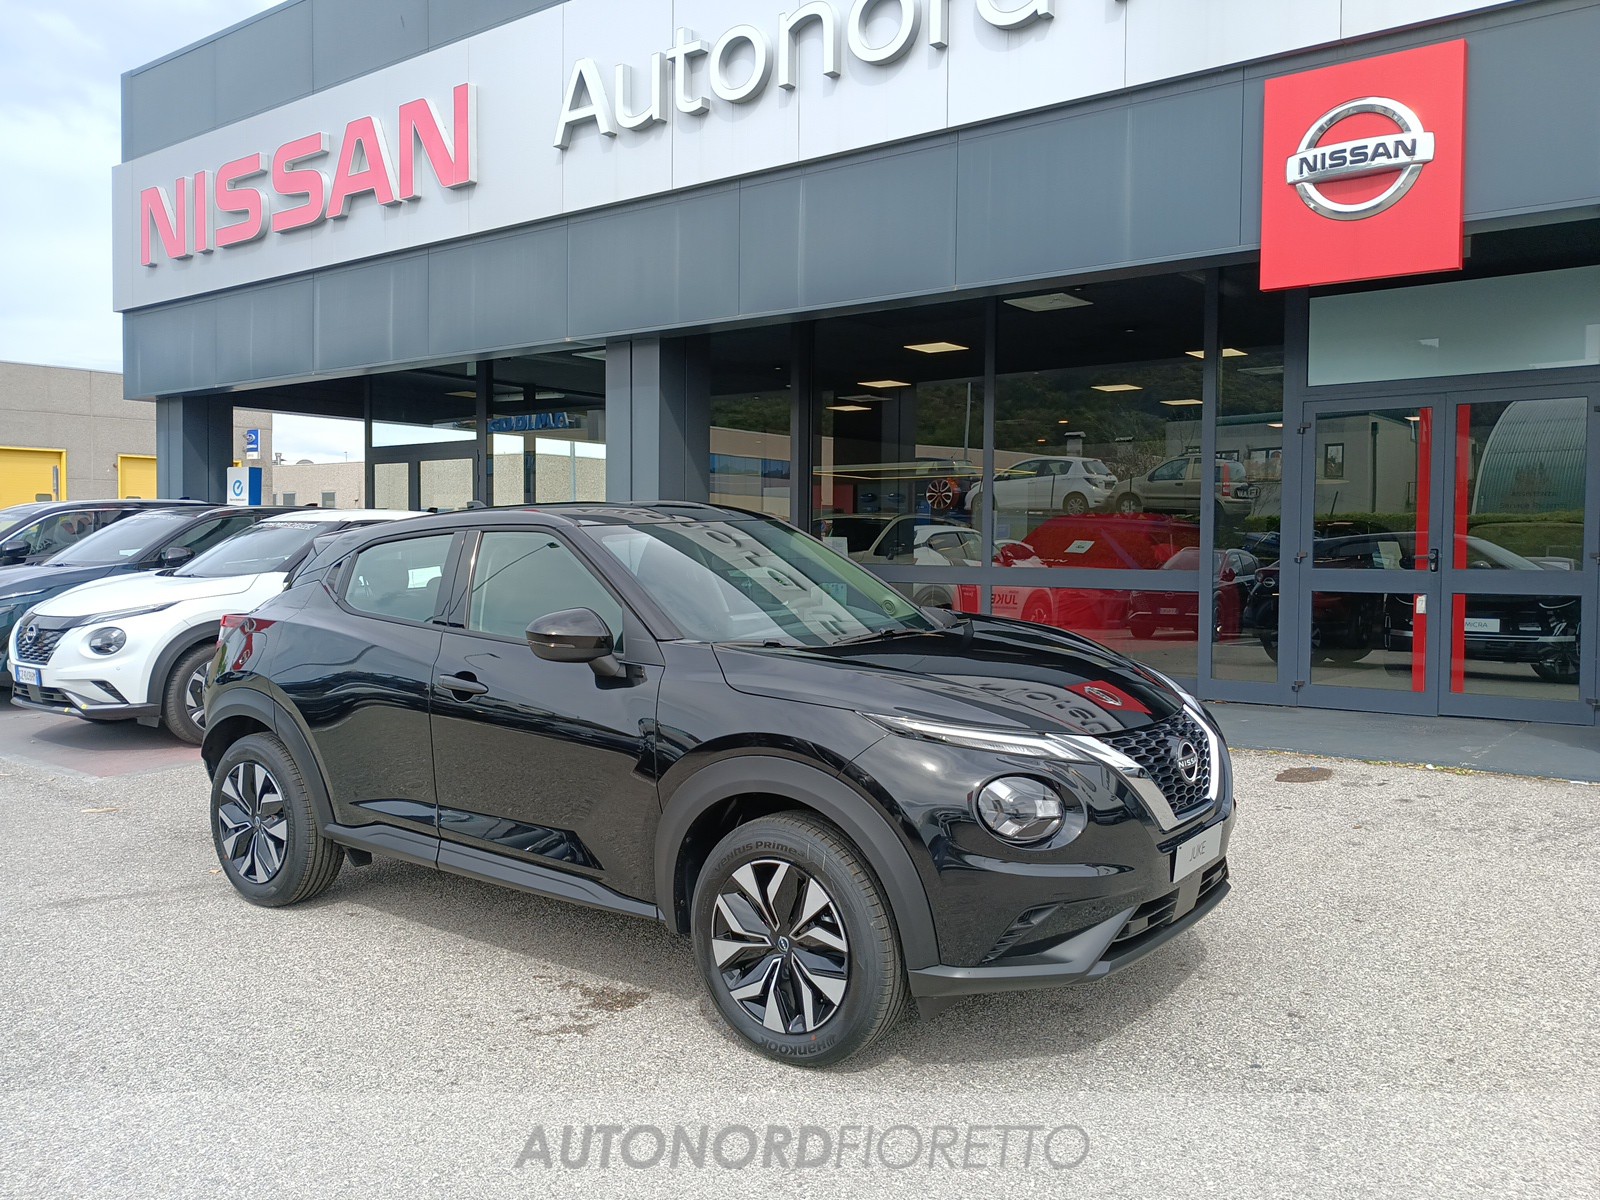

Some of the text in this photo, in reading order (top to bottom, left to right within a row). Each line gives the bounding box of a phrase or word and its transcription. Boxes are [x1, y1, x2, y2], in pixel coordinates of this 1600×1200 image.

[140, 82, 477, 267] NISSAN
[1298, 138, 1417, 175] NISSAN
[1189, 840, 1207, 862] JUKE
